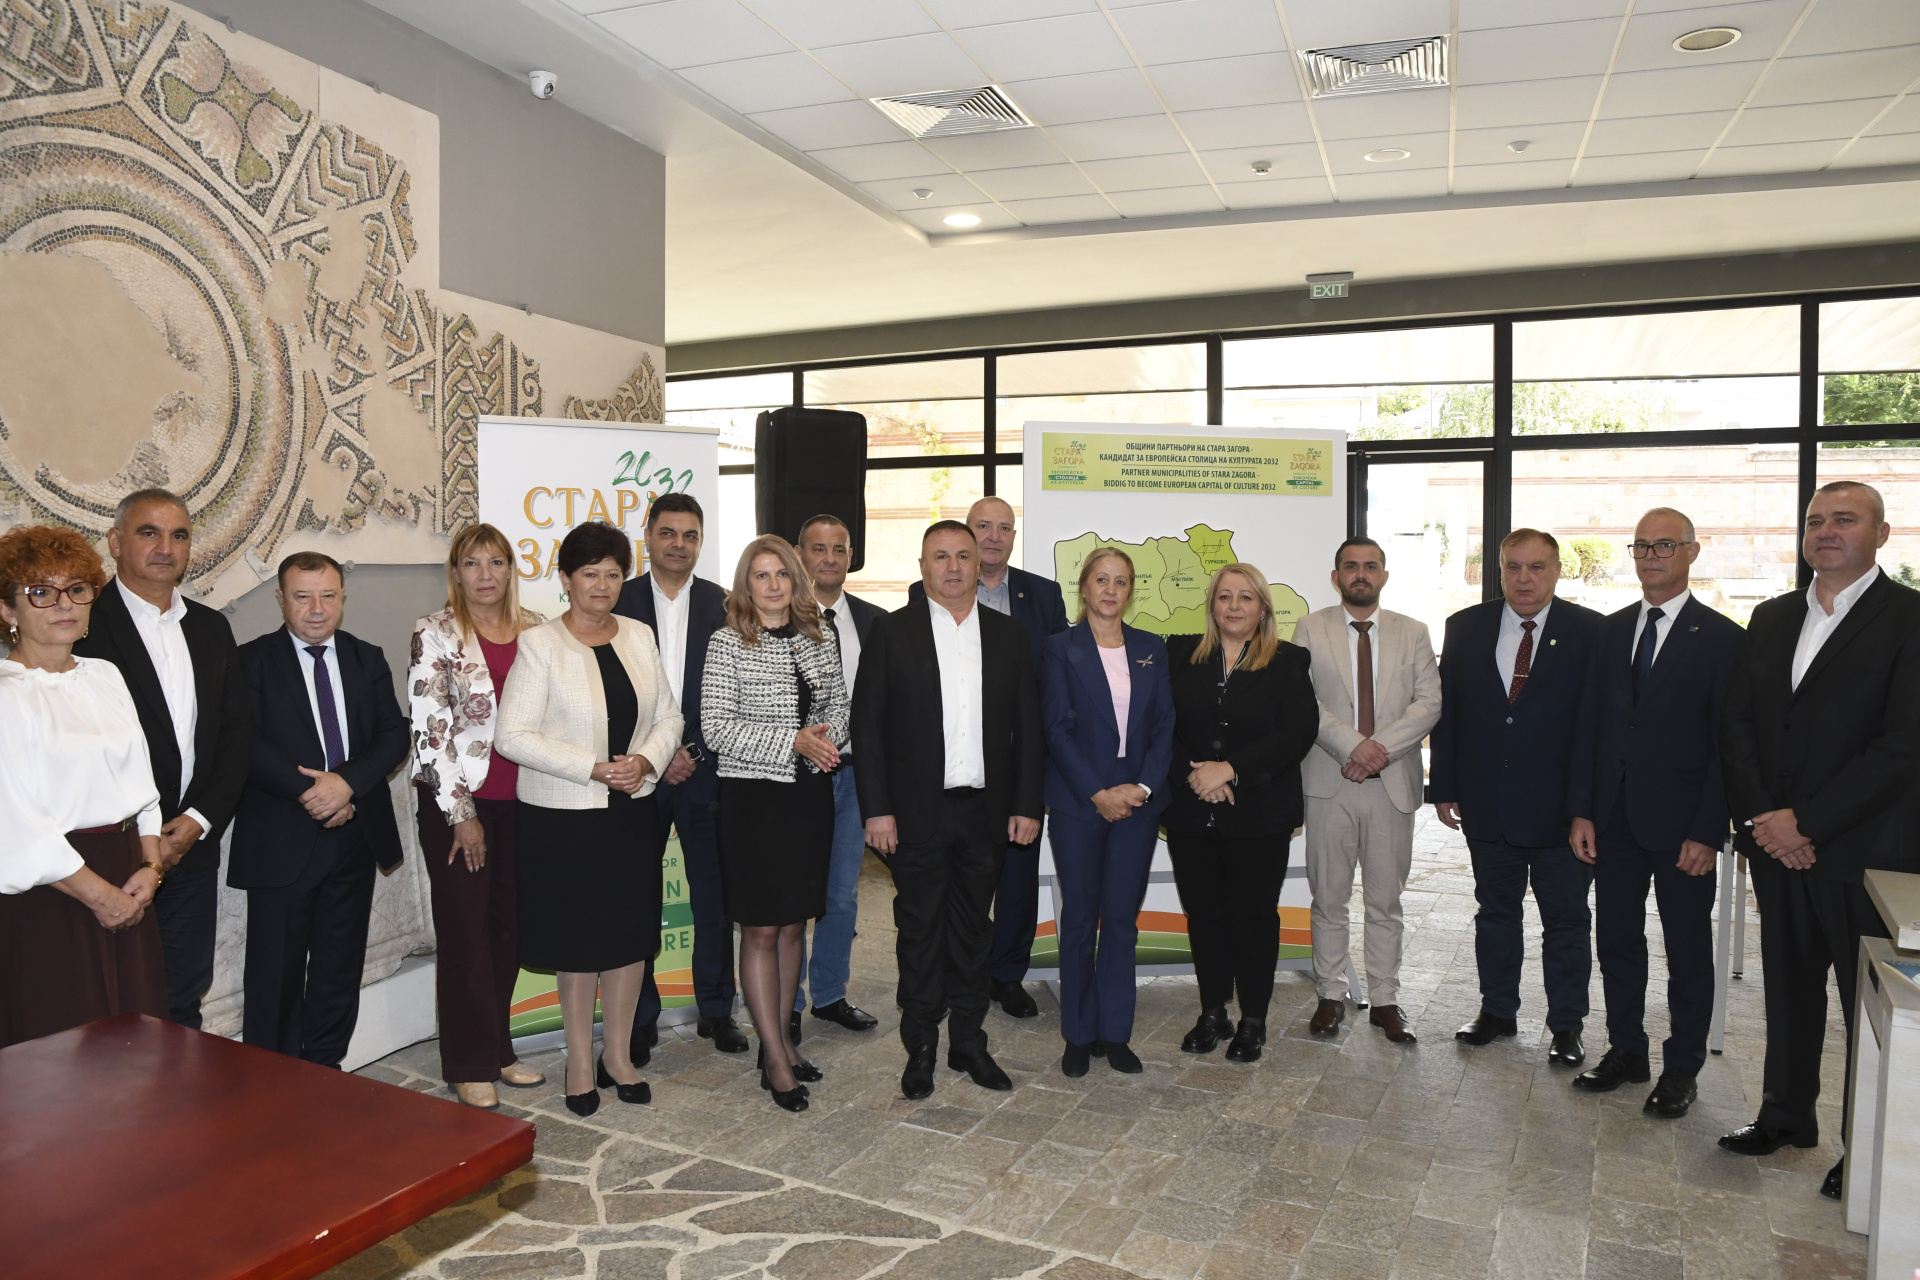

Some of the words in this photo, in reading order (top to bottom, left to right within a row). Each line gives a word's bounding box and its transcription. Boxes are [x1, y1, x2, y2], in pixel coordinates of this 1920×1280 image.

[1313, 283, 1344, 297] EXIT
[1054, 447, 1082, 456] СТАРА
[1125, 442, 1155, 451] ОБЩИНИ
[1157, 443, 1195, 451] ПАРТНЬОРИ
[1197, 444, 1206, 452] НА
[1227, 445, 1250, 453] ЗАГОРА
[1052, 456, 1085, 465] ЗАГОРА
[1099, 453, 1135, 462] КАНДИДАТ
[1136, 454, 1144, 462] ЗА
[1145, 454, 1187, 463] ЕВРОПЕЙСКА
[1188, 455, 1217, 464] СТОЛИЦА
[1219, 456, 1228, 464] НА
[1229, 457, 1263, 465] КУЛТУРАТА
[1264, 458, 1279, 466] 2032
[1293, 453, 1317, 461] STARA
[1290, 461, 1321, 471] ZAGORA
[612, 450, 697, 503] 2032
[1121, 468, 1150, 476] PARTNER
[1151, 469, 1200, 477] MUNICIPALITIES
[1202, 470, 1210, 478] OF
[1211, 470, 1231, 478] STARA
[1231, 471, 1256, 479] ZAGORA
[1103, 479, 1127, 487] BIDDIG
[1128, 480, 1136, 488] TO
[1137, 480, 1162, 488] BECOME
[1163, 481, 1197, 489] EUROPEAN
[1198, 481, 1223, 489] CAPITAL
[1224, 482, 1232, 490] OF
[1233, 482, 1260, 490] CULTURE
